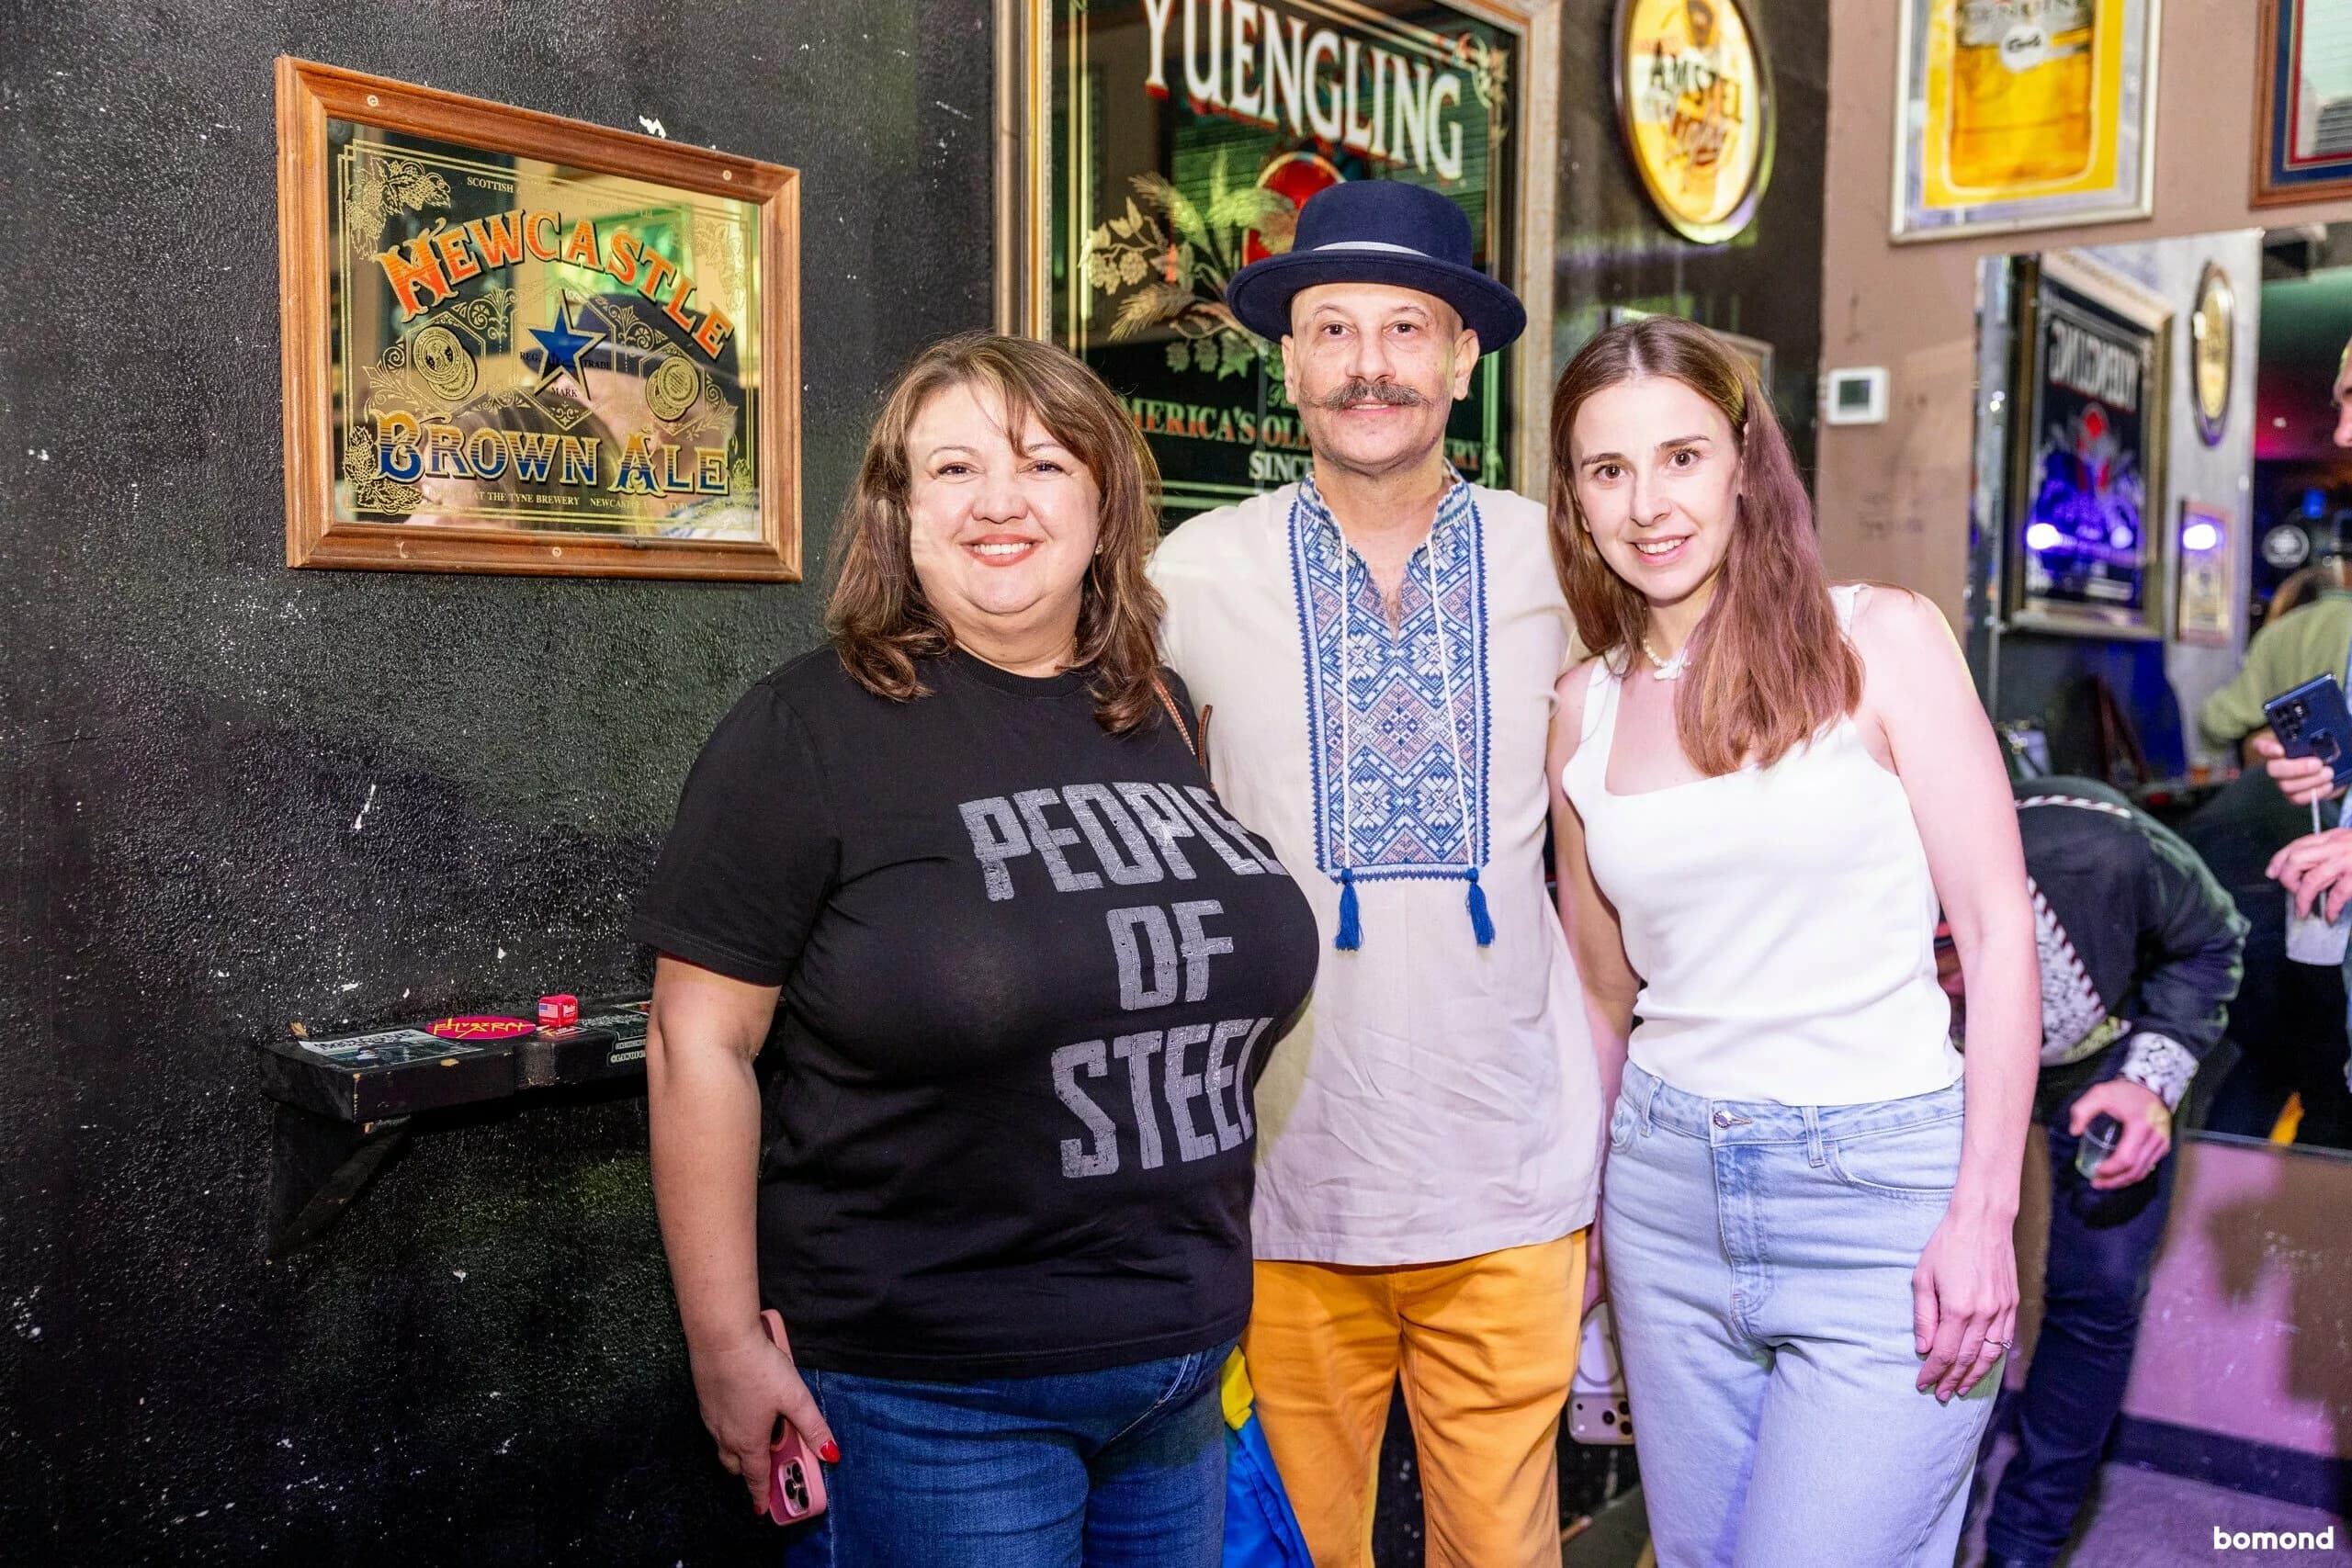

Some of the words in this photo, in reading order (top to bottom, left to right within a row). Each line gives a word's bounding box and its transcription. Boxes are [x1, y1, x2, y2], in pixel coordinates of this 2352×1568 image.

[1144, 0, 1464, 181] YUENGLING
[467, 175, 514, 193] SCOTTISH
[372, 209, 735, 359] NEWCASTLE
[551, 387, 578, 398] MARK
[1116, 397, 1257, 445] MERICA'S
[373, 410, 603, 485] BROWN
[607, 427, 729, 498] ALE
[487, 491, 506, 502] THE
[510, 492, 535, 503] TYNE
[537, 494, 581, 506] BREWERY
[958, 782, 1290, 901] PEOPLE
[1105, 899, 1234, 1010] OF
[1051, 1017, 1274, 1179] STEEL
